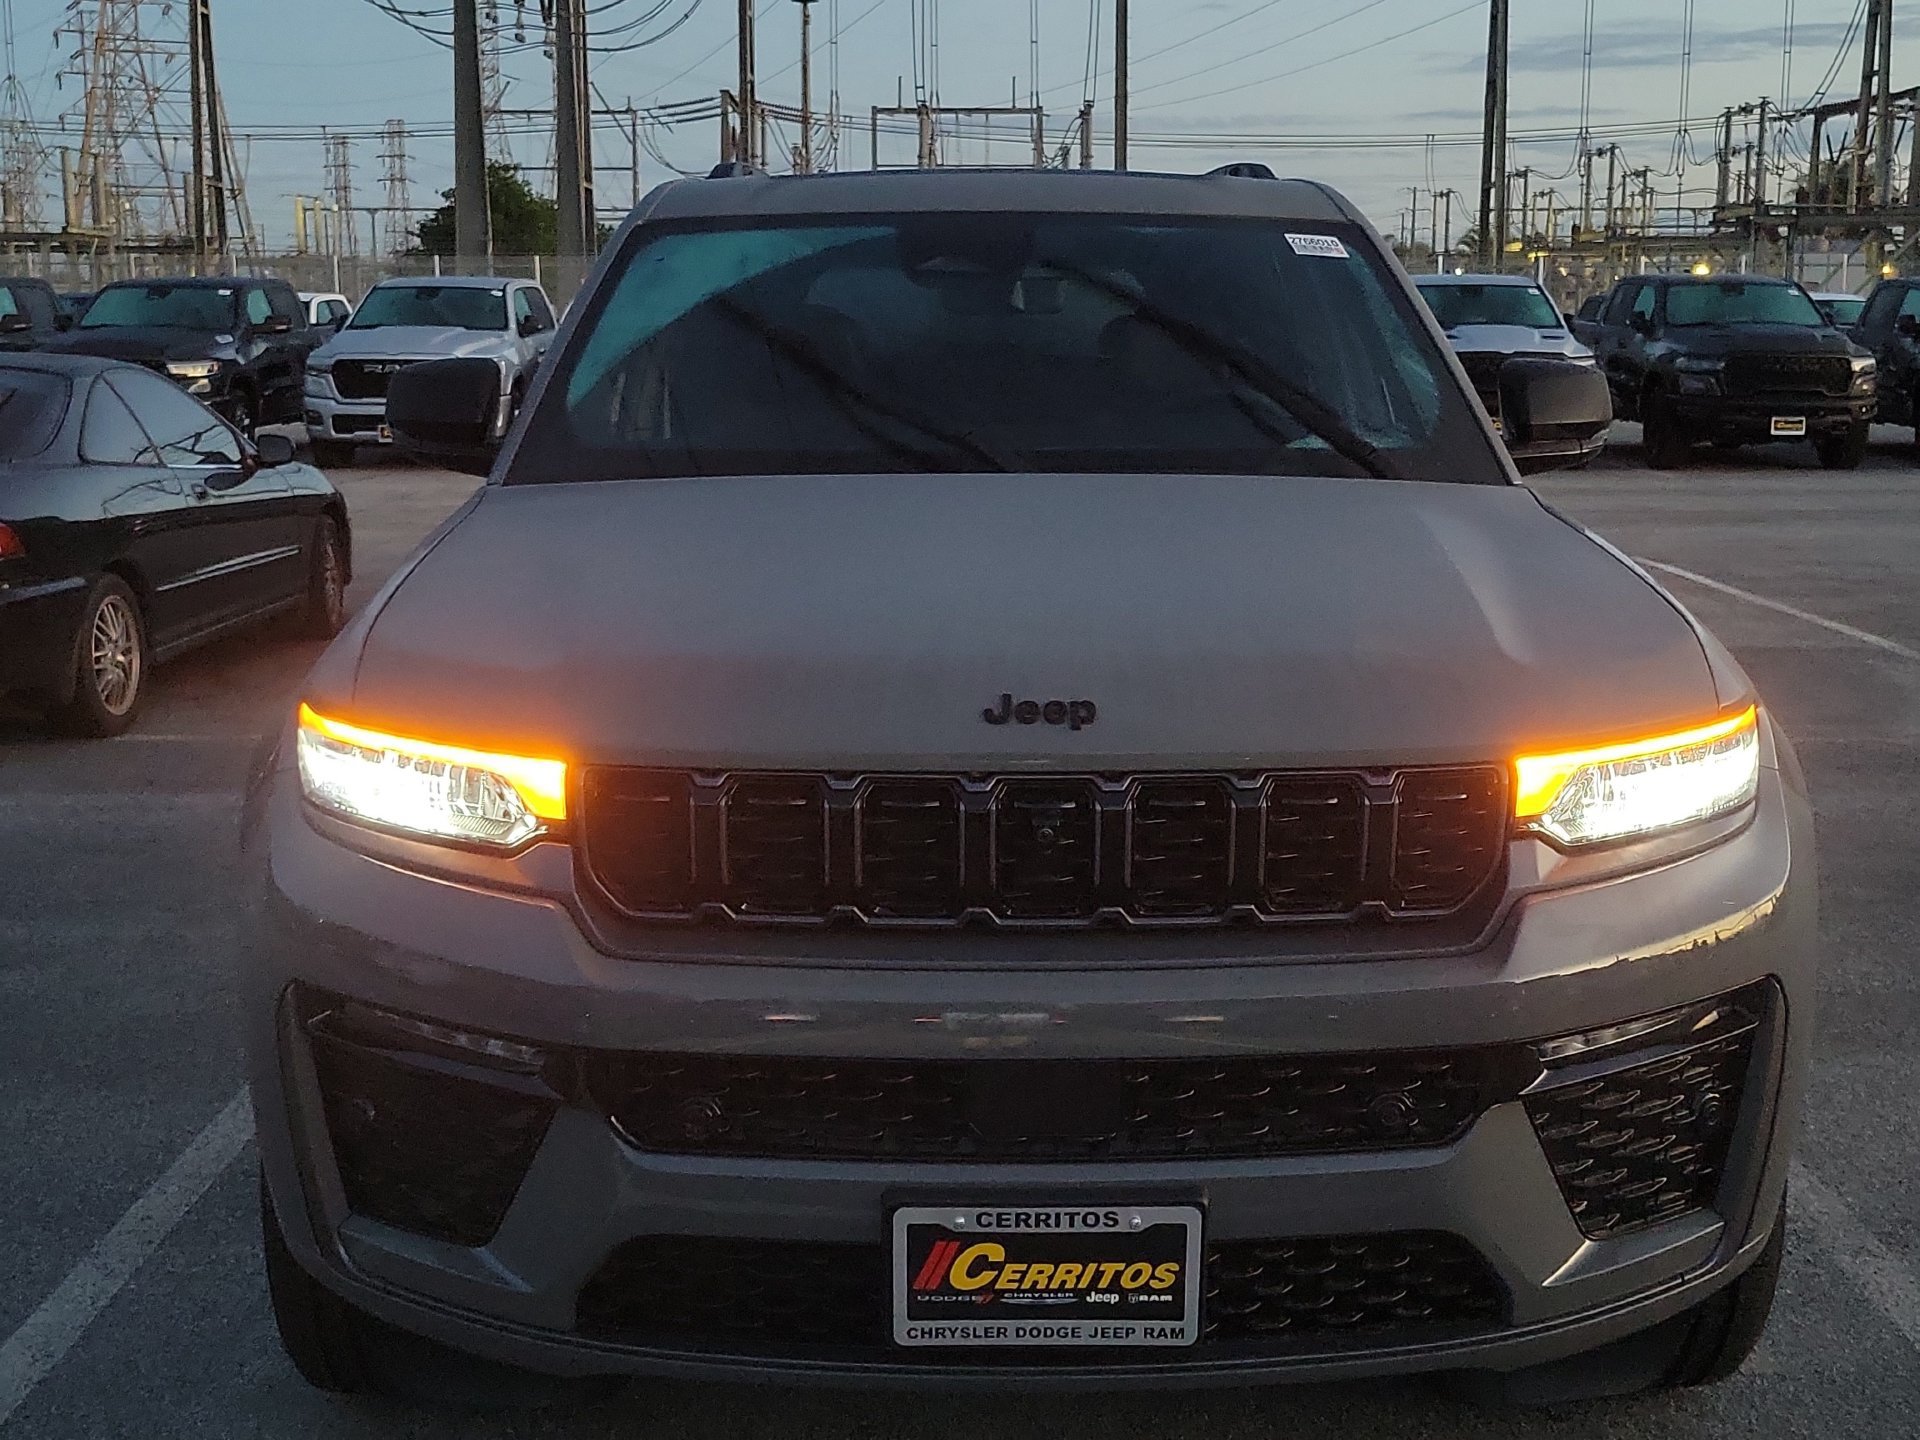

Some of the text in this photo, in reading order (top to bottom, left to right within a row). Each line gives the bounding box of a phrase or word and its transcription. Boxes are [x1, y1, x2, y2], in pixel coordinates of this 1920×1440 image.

[363, 364, 401, 374] RA
[983, 693, 1097, 731] Jeep
[975, 1210, 1120, 1229] CERRITOS
[949, 1242, 1180, 1291] CERRITOS
[917, 1294, 983, 1302] DODGE
[1086, 1291, 1120, 1304] Jeep
[1138, 1294, 1173, 1302] RAM
[906, 1326, 1185, 1340] CHRYSLER DODGE JEEP RAM
